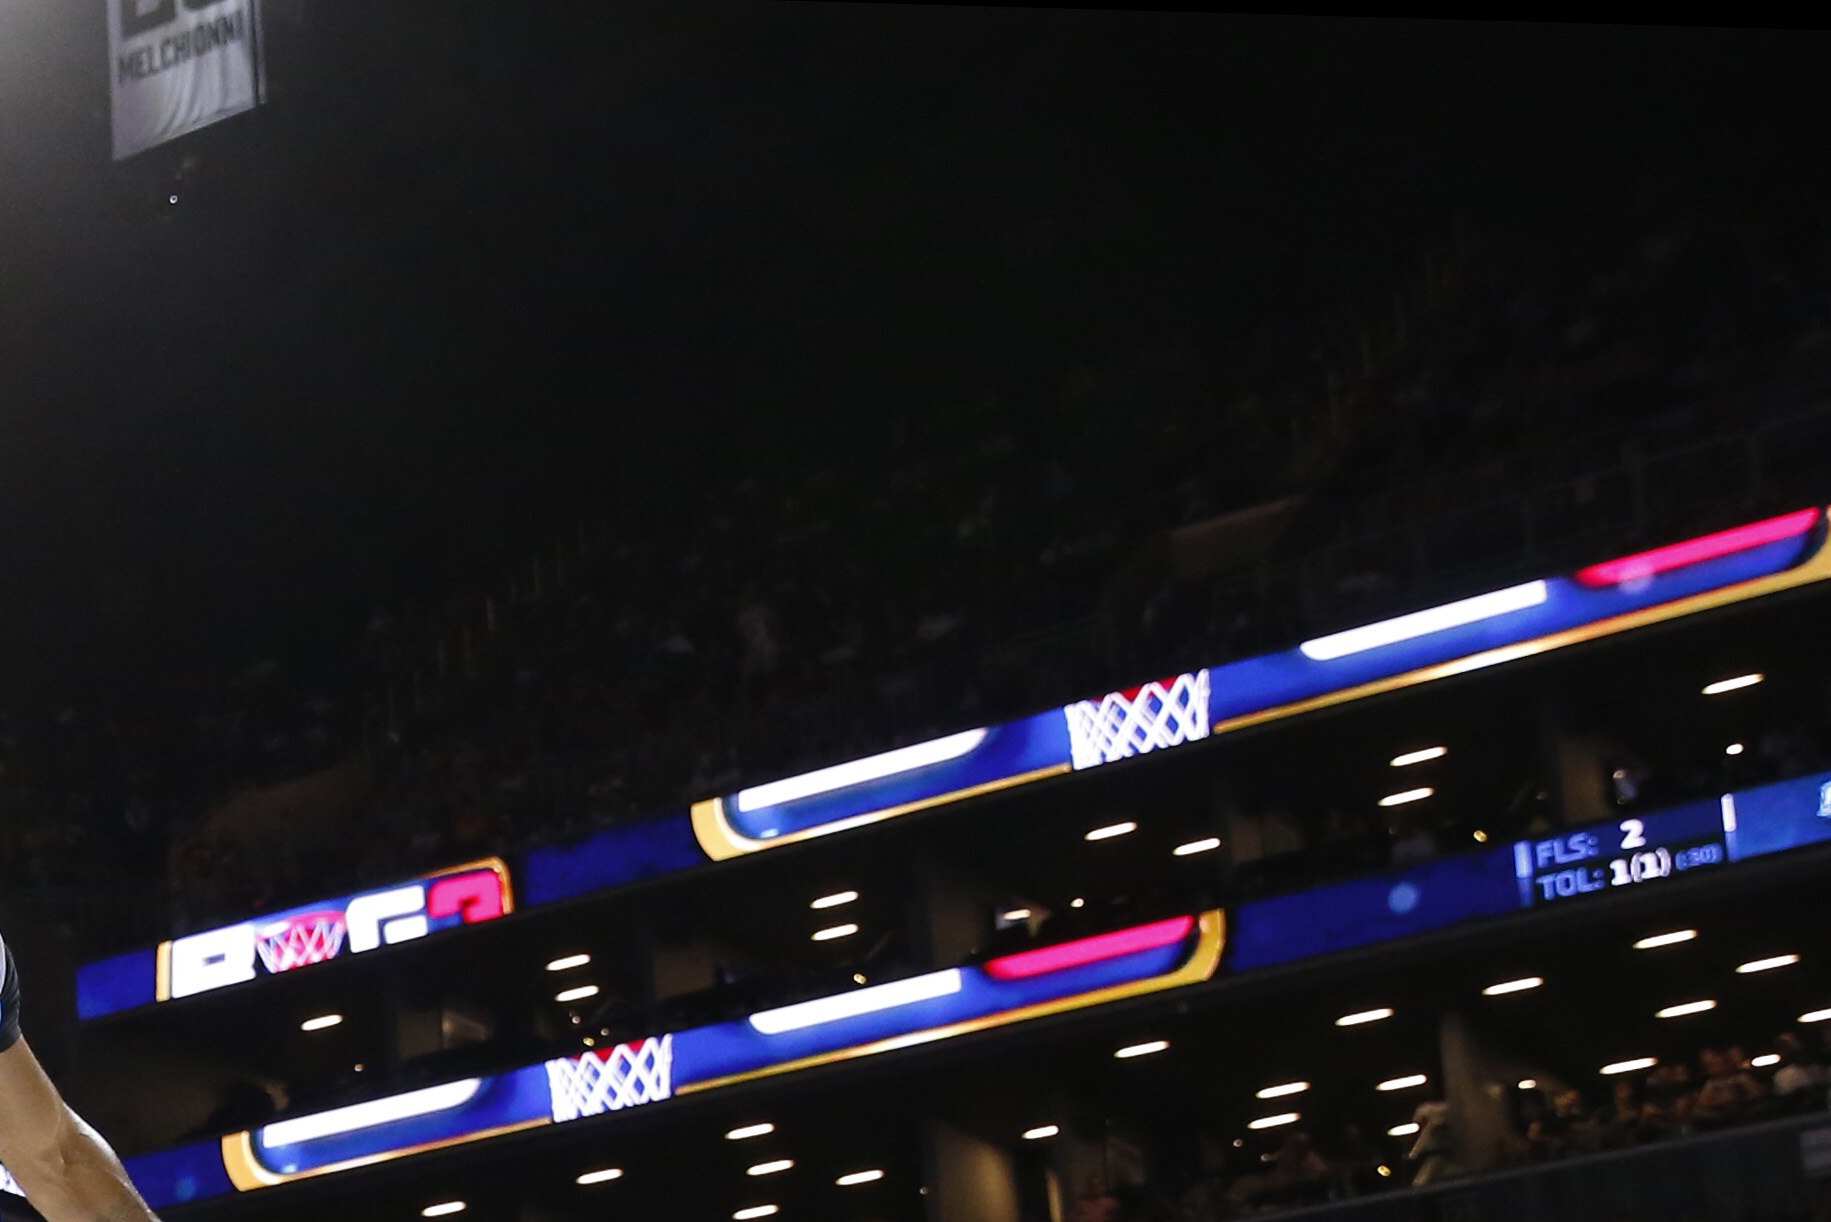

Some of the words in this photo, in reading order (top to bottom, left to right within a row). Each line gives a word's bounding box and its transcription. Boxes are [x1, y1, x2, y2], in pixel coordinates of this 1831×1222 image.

[1535, 831, 1599, 868] FLS:
[1619, 818, 1647, 850] 2
[1536, 866, 1606, 900] TOL:
